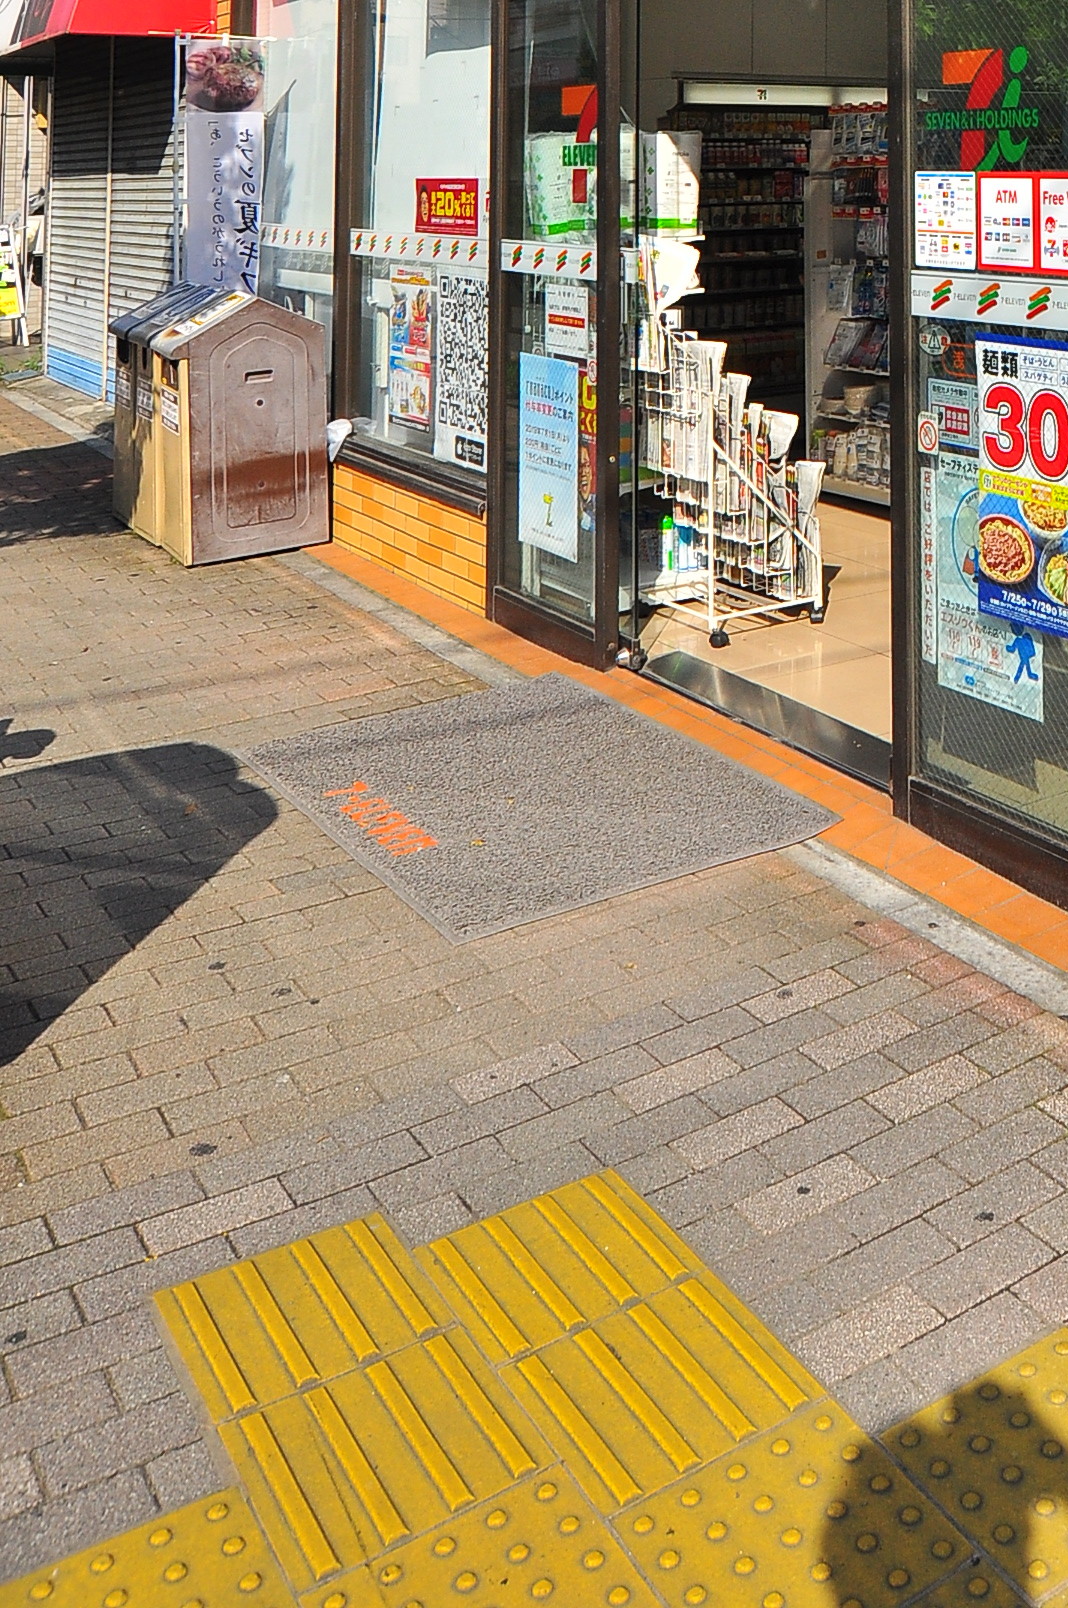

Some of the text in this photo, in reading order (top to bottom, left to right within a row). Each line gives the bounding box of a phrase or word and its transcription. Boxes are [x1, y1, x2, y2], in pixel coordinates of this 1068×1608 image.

[976, 108, 1039, 130] HOLDINGS
[995, 190, 1018, 204] ATM
[1042, 190, 1065, 206] Free
[981, 348, 1019, 379] 麺類
[1023, 370, 1054, 383] スパゲティ
